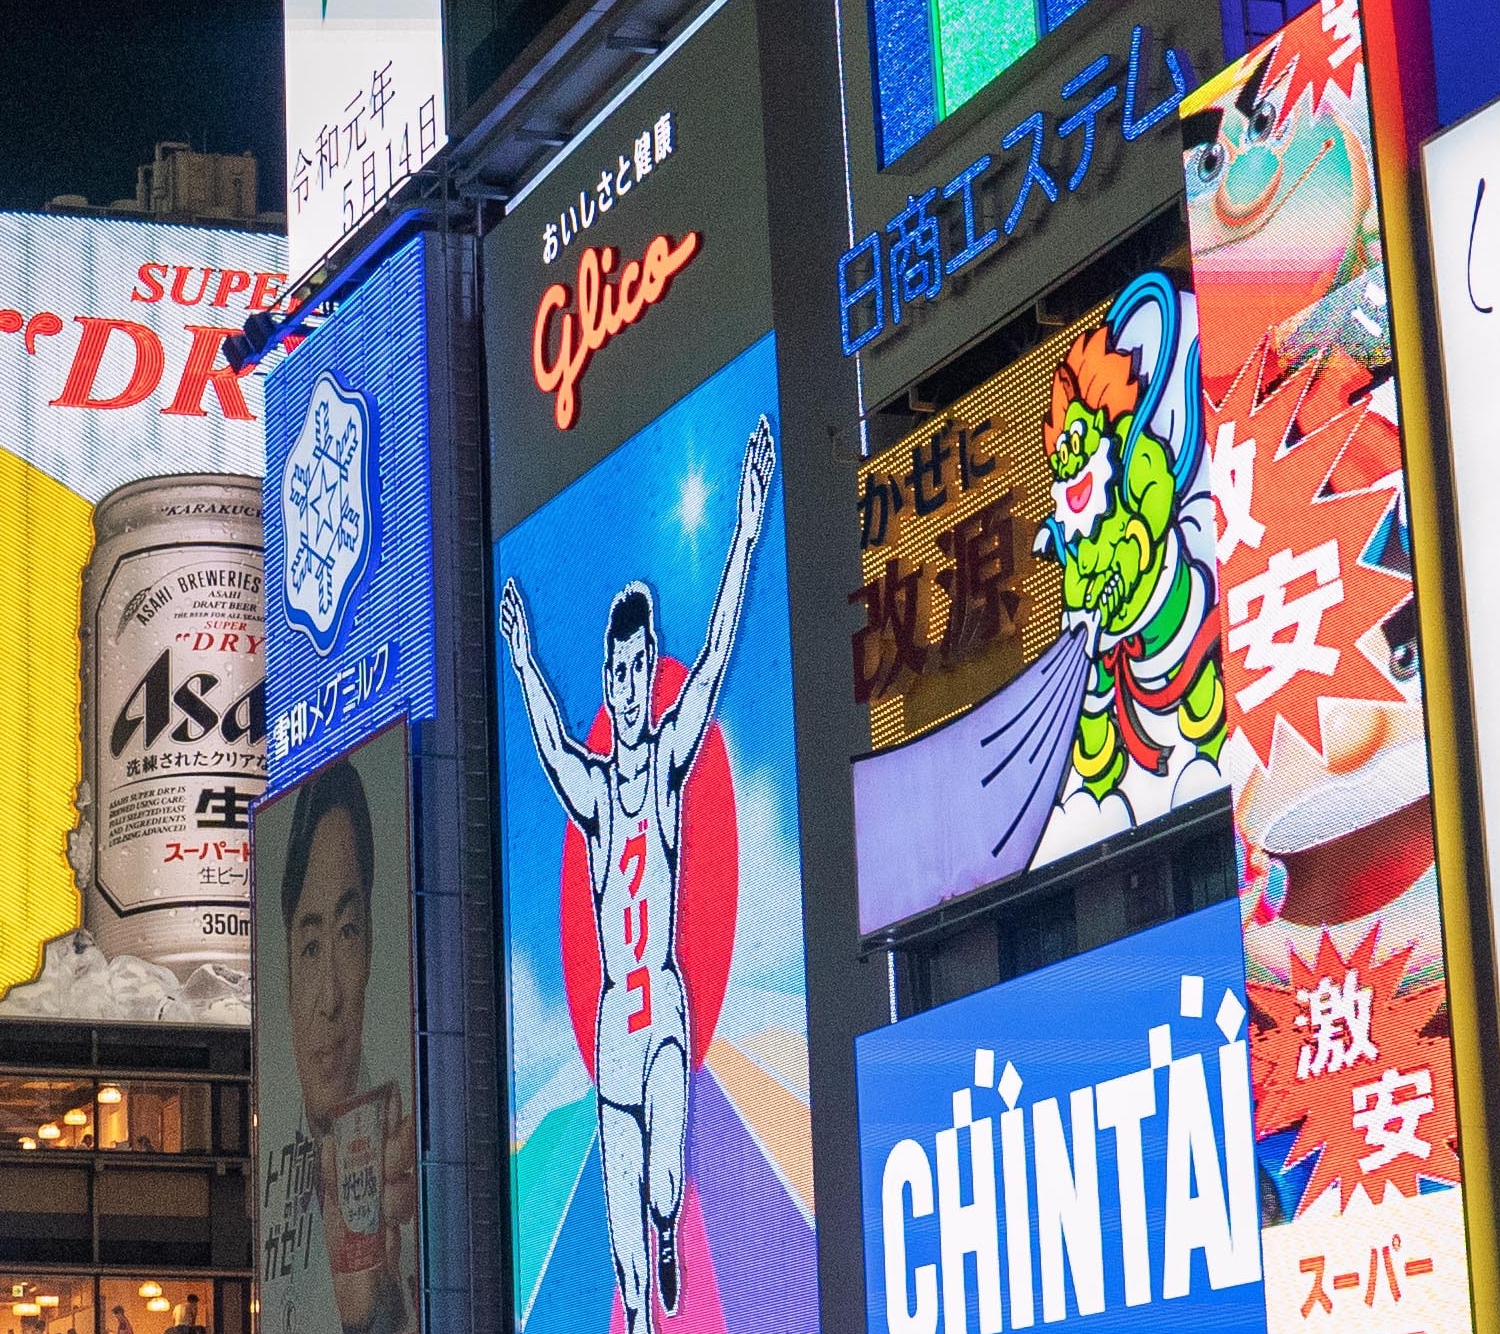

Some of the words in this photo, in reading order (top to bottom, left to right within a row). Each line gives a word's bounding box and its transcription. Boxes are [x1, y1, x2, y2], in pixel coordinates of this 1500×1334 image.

[289, 58, 396, 216] 令和元年
[340, 92, 441, 236] 5月14日
[542, 110, 674, 265] おいしさと健康
[837, 23, 1189, 358] 日商エステム
[131, 262, 305, 313] SUPE
[532, 230, 702, 432] Glico
[857, 417, 996, 551] かぜに
[138, 585, 173, 628] ASAHI
[176, 569, 262, 595] BREWERIES
[192, 600, 226, 611] DRAFT
[228, 602, 258, 613] BEER
[208, 590, 242, 600] ASAHI
[848, 485, 1031, 707] 改源
[203, 620, 248, 632] SUPER
[270, 642, 391, 762] 雪印メグミルク
[126, 749, 268, 778] 洗練されたクリアな
[127, 815, 187, 834] INGREDIENTS
[130, 809, 162, 824] SELECTED
[163, 804, 186, 817] YEAST
[131, 791, 157, 805] SUPER
[158, 787, 175, 799] DRY
[177, 786, 186, 795] IS
[136, 800, 158, 812] USING
[194, 786, 250, 829] 生
[146, 824, 186, 840] ADVANCED
[618, 815, 656, 1035] グリコ
[1295, 977, 1434, 1177] 激安
[1299, 1234, 1434, 1322] スーパー
